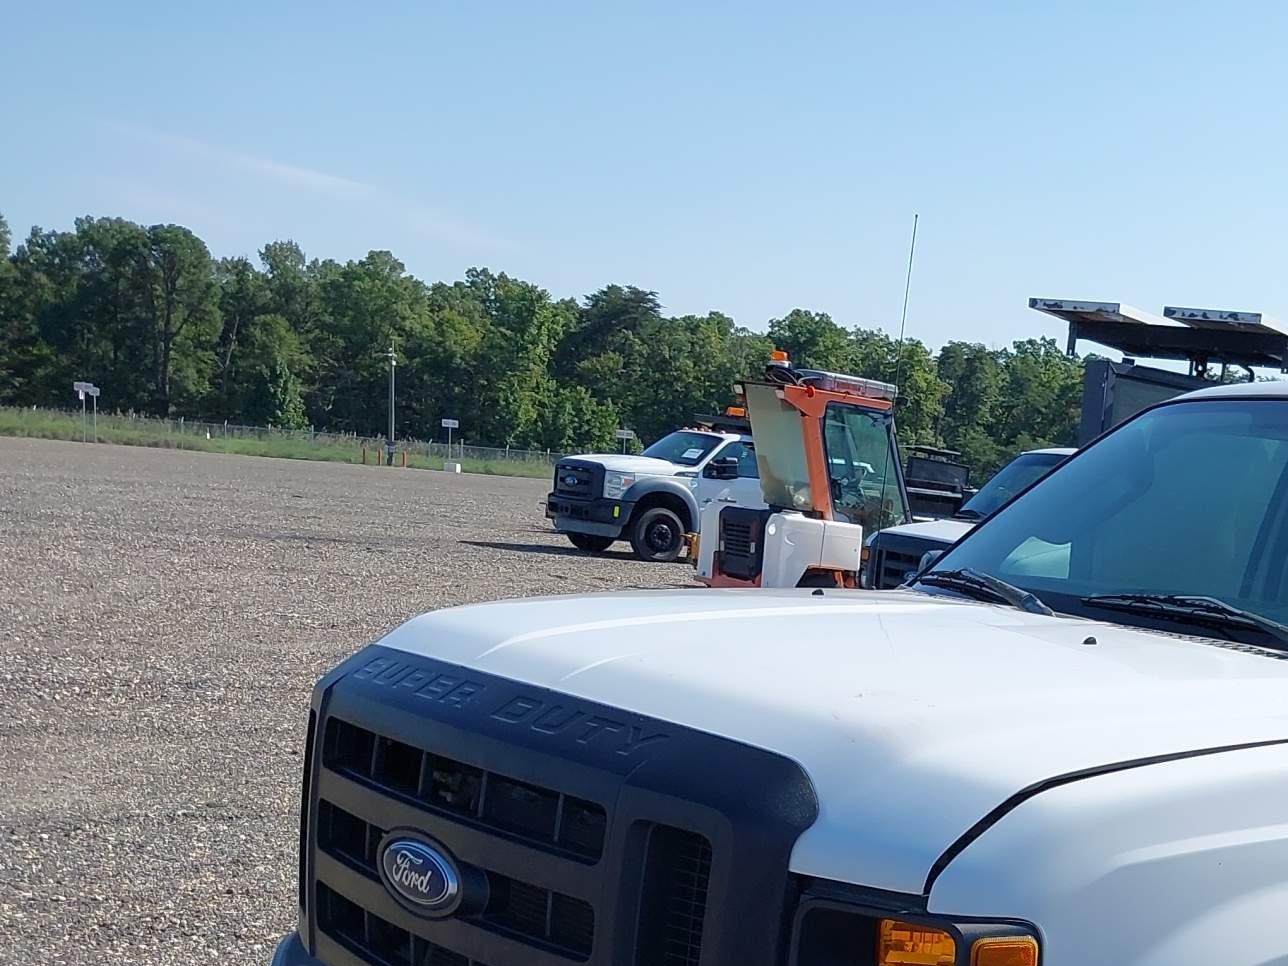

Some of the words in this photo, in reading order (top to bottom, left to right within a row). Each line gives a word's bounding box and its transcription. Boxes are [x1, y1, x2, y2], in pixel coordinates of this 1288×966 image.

[353, 655, 486, 708] SUPER
[490, 695, 669, 756] DUTY
[392, 850, 432, 893] Ford
